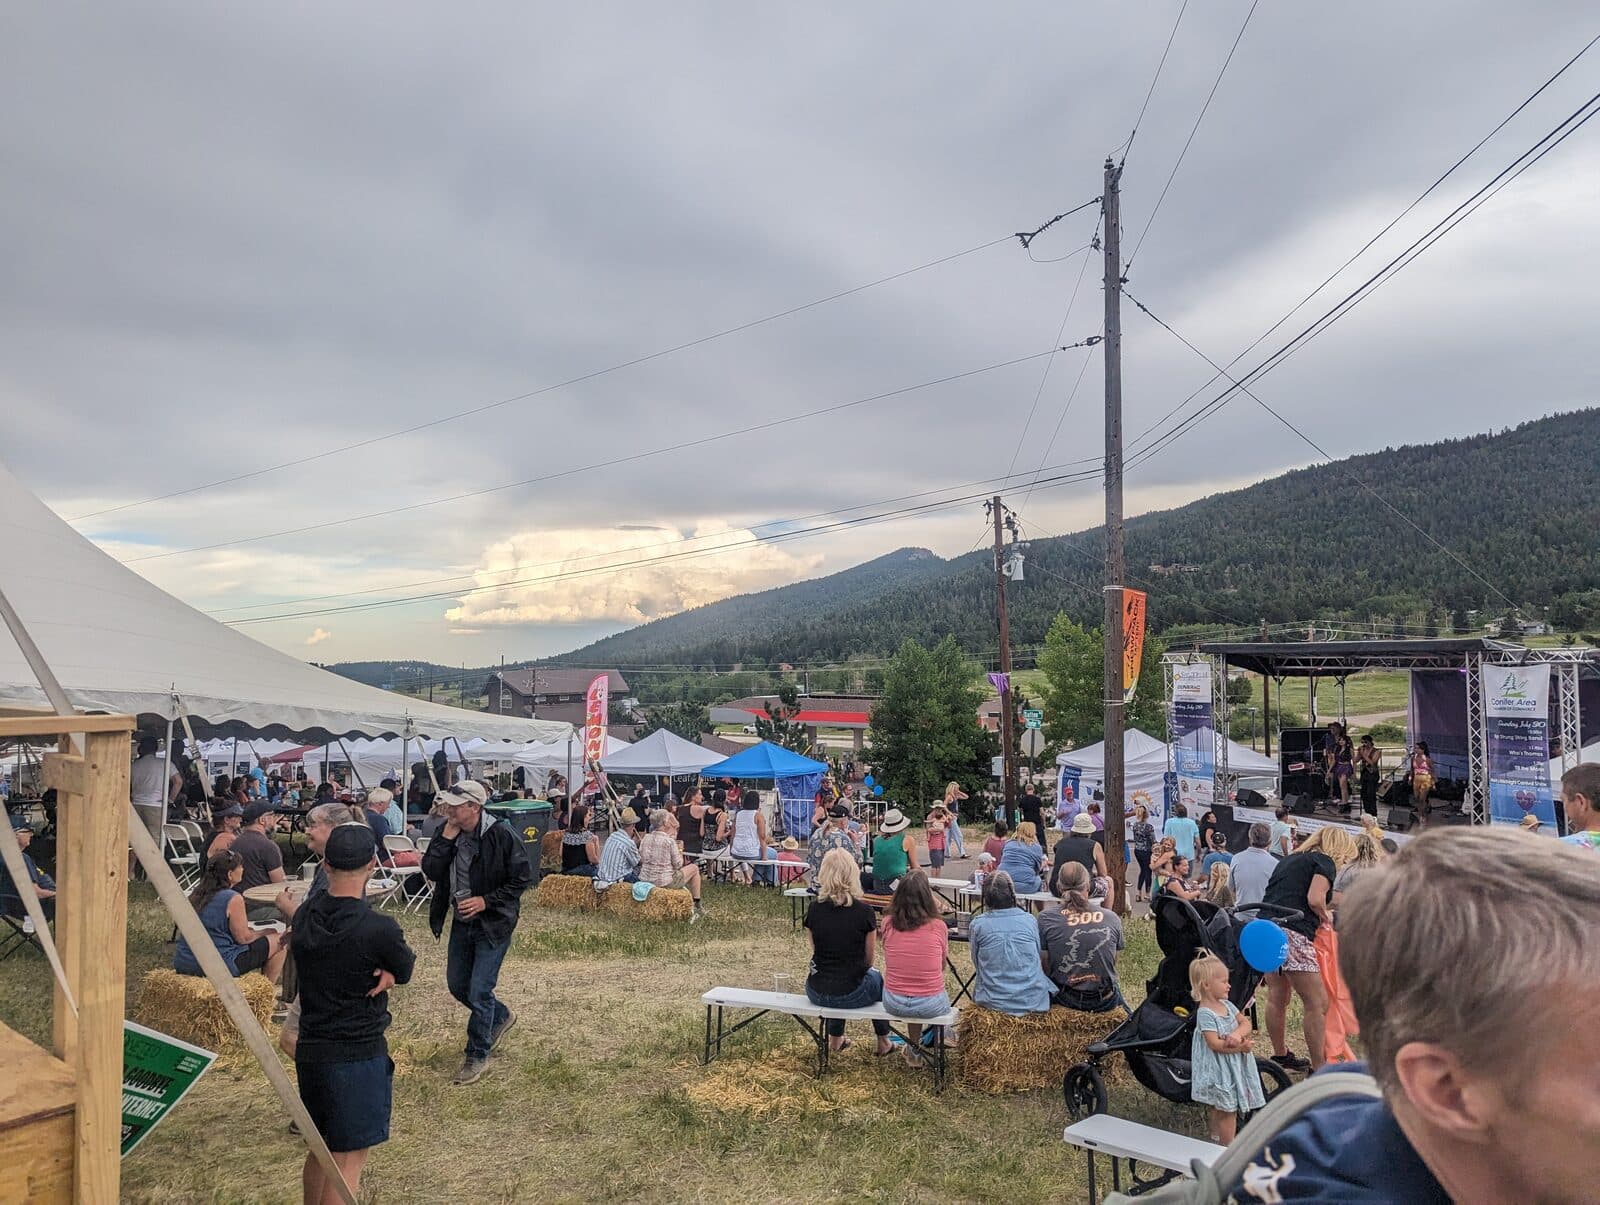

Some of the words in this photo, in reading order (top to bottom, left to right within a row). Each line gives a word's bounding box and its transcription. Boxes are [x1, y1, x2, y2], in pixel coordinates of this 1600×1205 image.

[1490, 698, 1514, 706] Conifer
[1519, 720, 1531, 729] July
[1067, 911, 1104, 926] 500
[124, 1067, 174, 1095] GOODBYE
[122, 1093, 167, 1120] NTERNET
